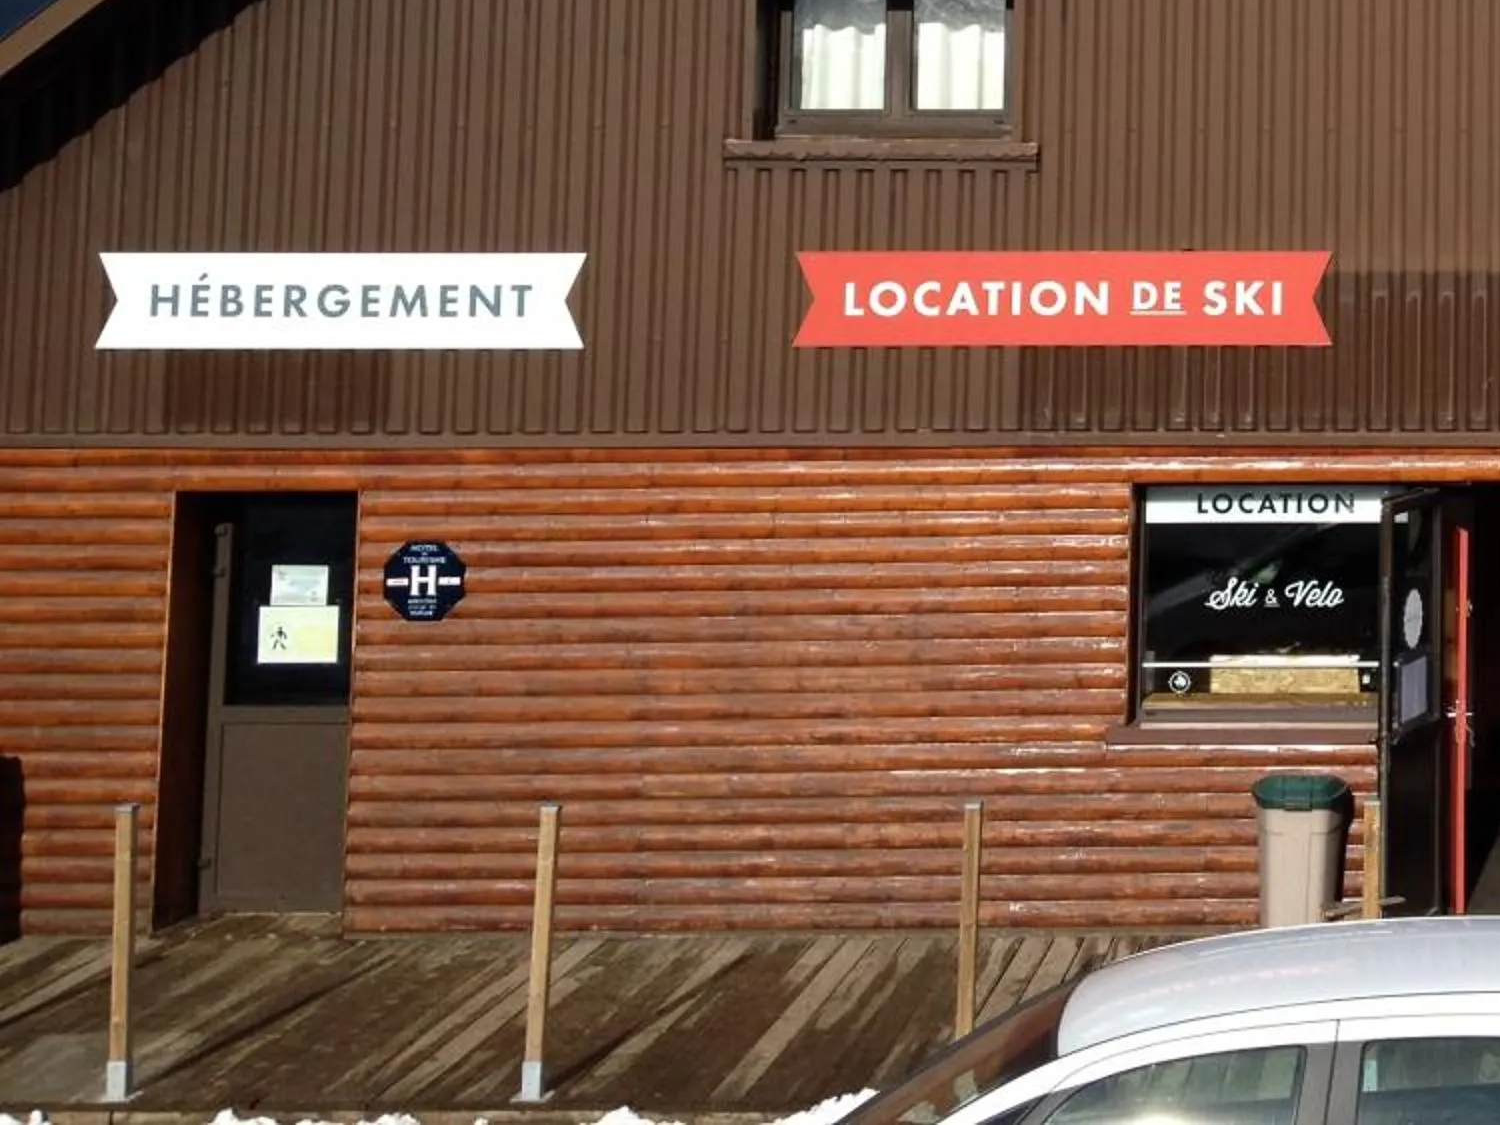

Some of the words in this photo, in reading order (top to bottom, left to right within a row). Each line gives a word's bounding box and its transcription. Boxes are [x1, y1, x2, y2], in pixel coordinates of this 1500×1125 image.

[150, 272, 533, 318] HÉBERGEMENT
[844, 280, 1109, 317] LOCATION
[1130, 281, 1187, 315] DE
[1202, 280, 1283, 316] SKI
[1197, 493, 1355, 514] LOCATION
[410, 565, 437, 596] H
[1204, 577, 1260, 610] Ski
[1264, 588, 1279, 608] &
[1284, 580, 1344, 608] Velo
